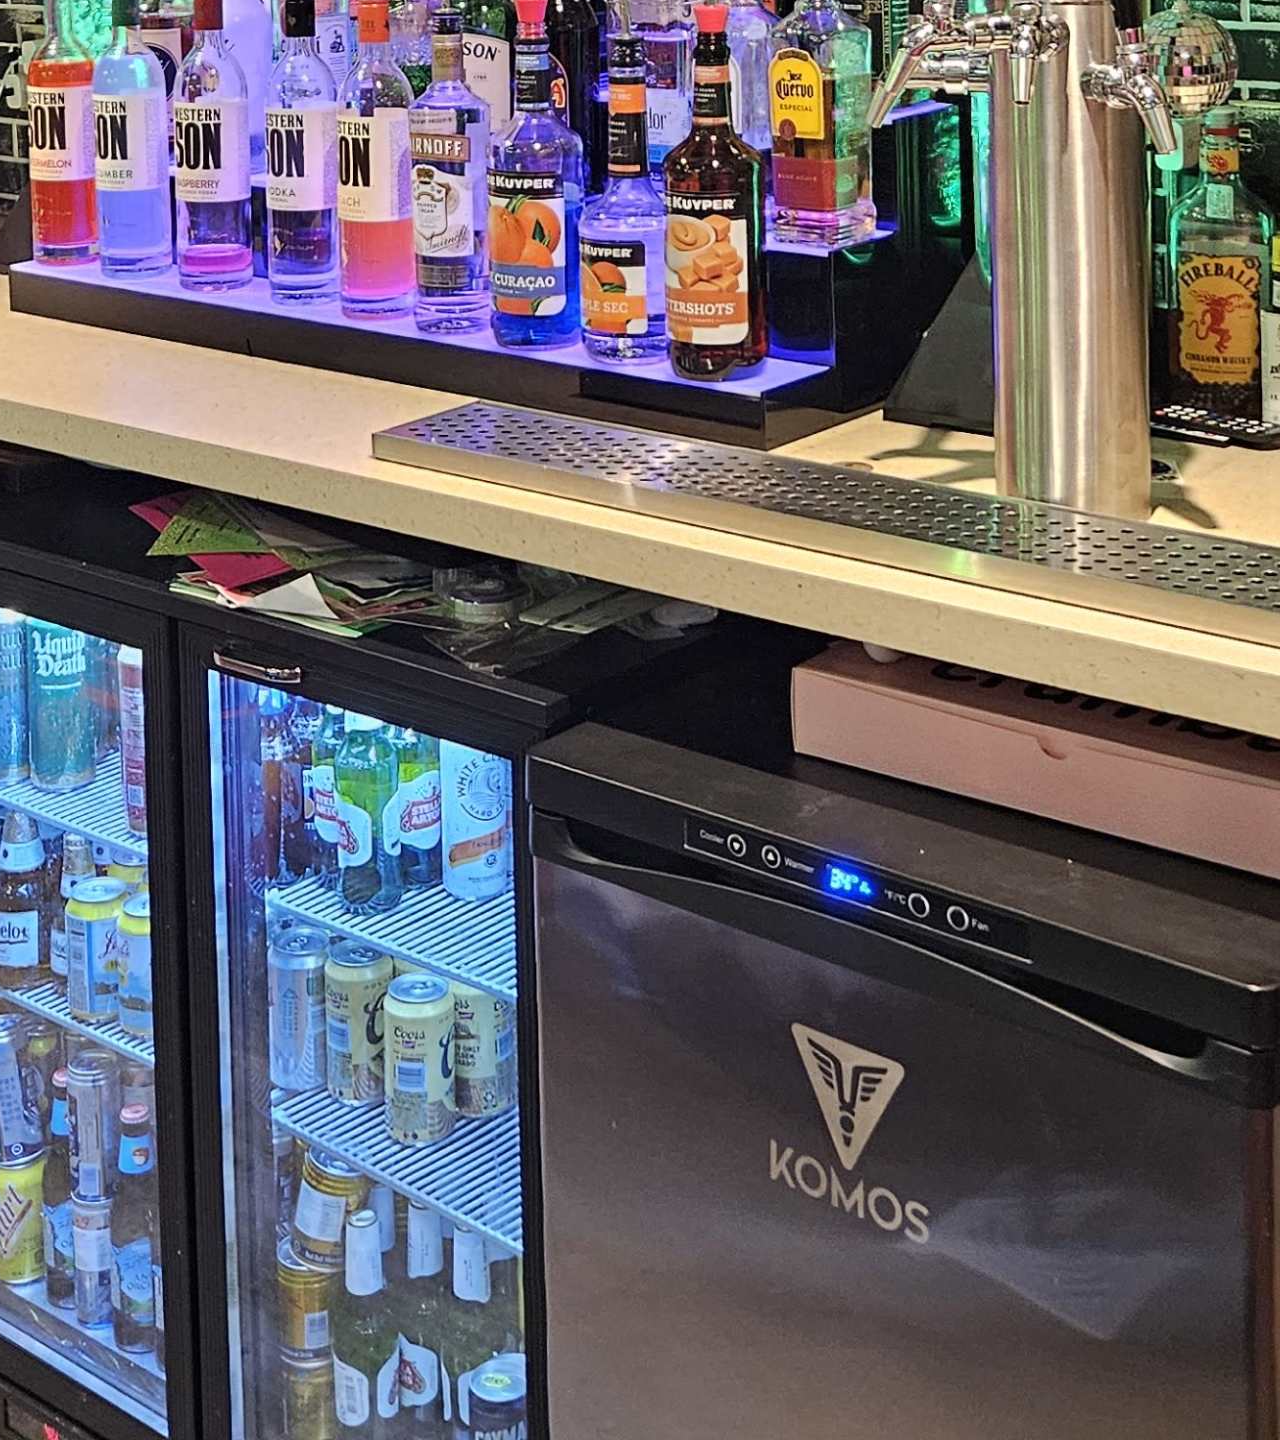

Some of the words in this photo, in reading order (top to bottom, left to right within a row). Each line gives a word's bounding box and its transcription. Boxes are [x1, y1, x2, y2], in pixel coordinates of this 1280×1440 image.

[776, 78, 814, 100] Cuervo
[29, 92, 65, 105] STERN
[95, 101, 126, 113] TERN
[780, 103, 813, 112] ESPECIAL
[266, 113, 304, 127] ESTERN
[337, 121, 370, 135] STERN
[95, 114, 128, 160] ON
[176, 123, 221, 169] SON
[412, 137, 464, 156] RNOFF
[339, 136, 370, 187] ON
[98, 169, 133, 179] UMBER
[496, 176, 554, 189] KUYPER
[269, 186, 296, 197] ODKA
[673, 196, 736, 210] KUYPER
[584, 245, 632, 258] KUYPER
[495, 274, 555, 291] CURAÇAO
[1180, 262, 1259, 291] FIREBALL
[585, 300, 601, 311] PLE
[603, 300, 629, 313] SEC
[669, 301, 734, 315] TERSHOTS
[1185, 352, 1221, 363] CINNAMON
[1223, 355, 1252, 364] WHISKY
[32, 630, 86, 660] Liquid
[36, 653, 86, 677] Death
[456, 758, 480, 799] WHITE
[783, 856, 815, 874] Warmer
[971, 917, 990, 932] Fan
[394, 1026, 426, 1040] Coors
[768, 1138, 930, 1245] KOMOS
